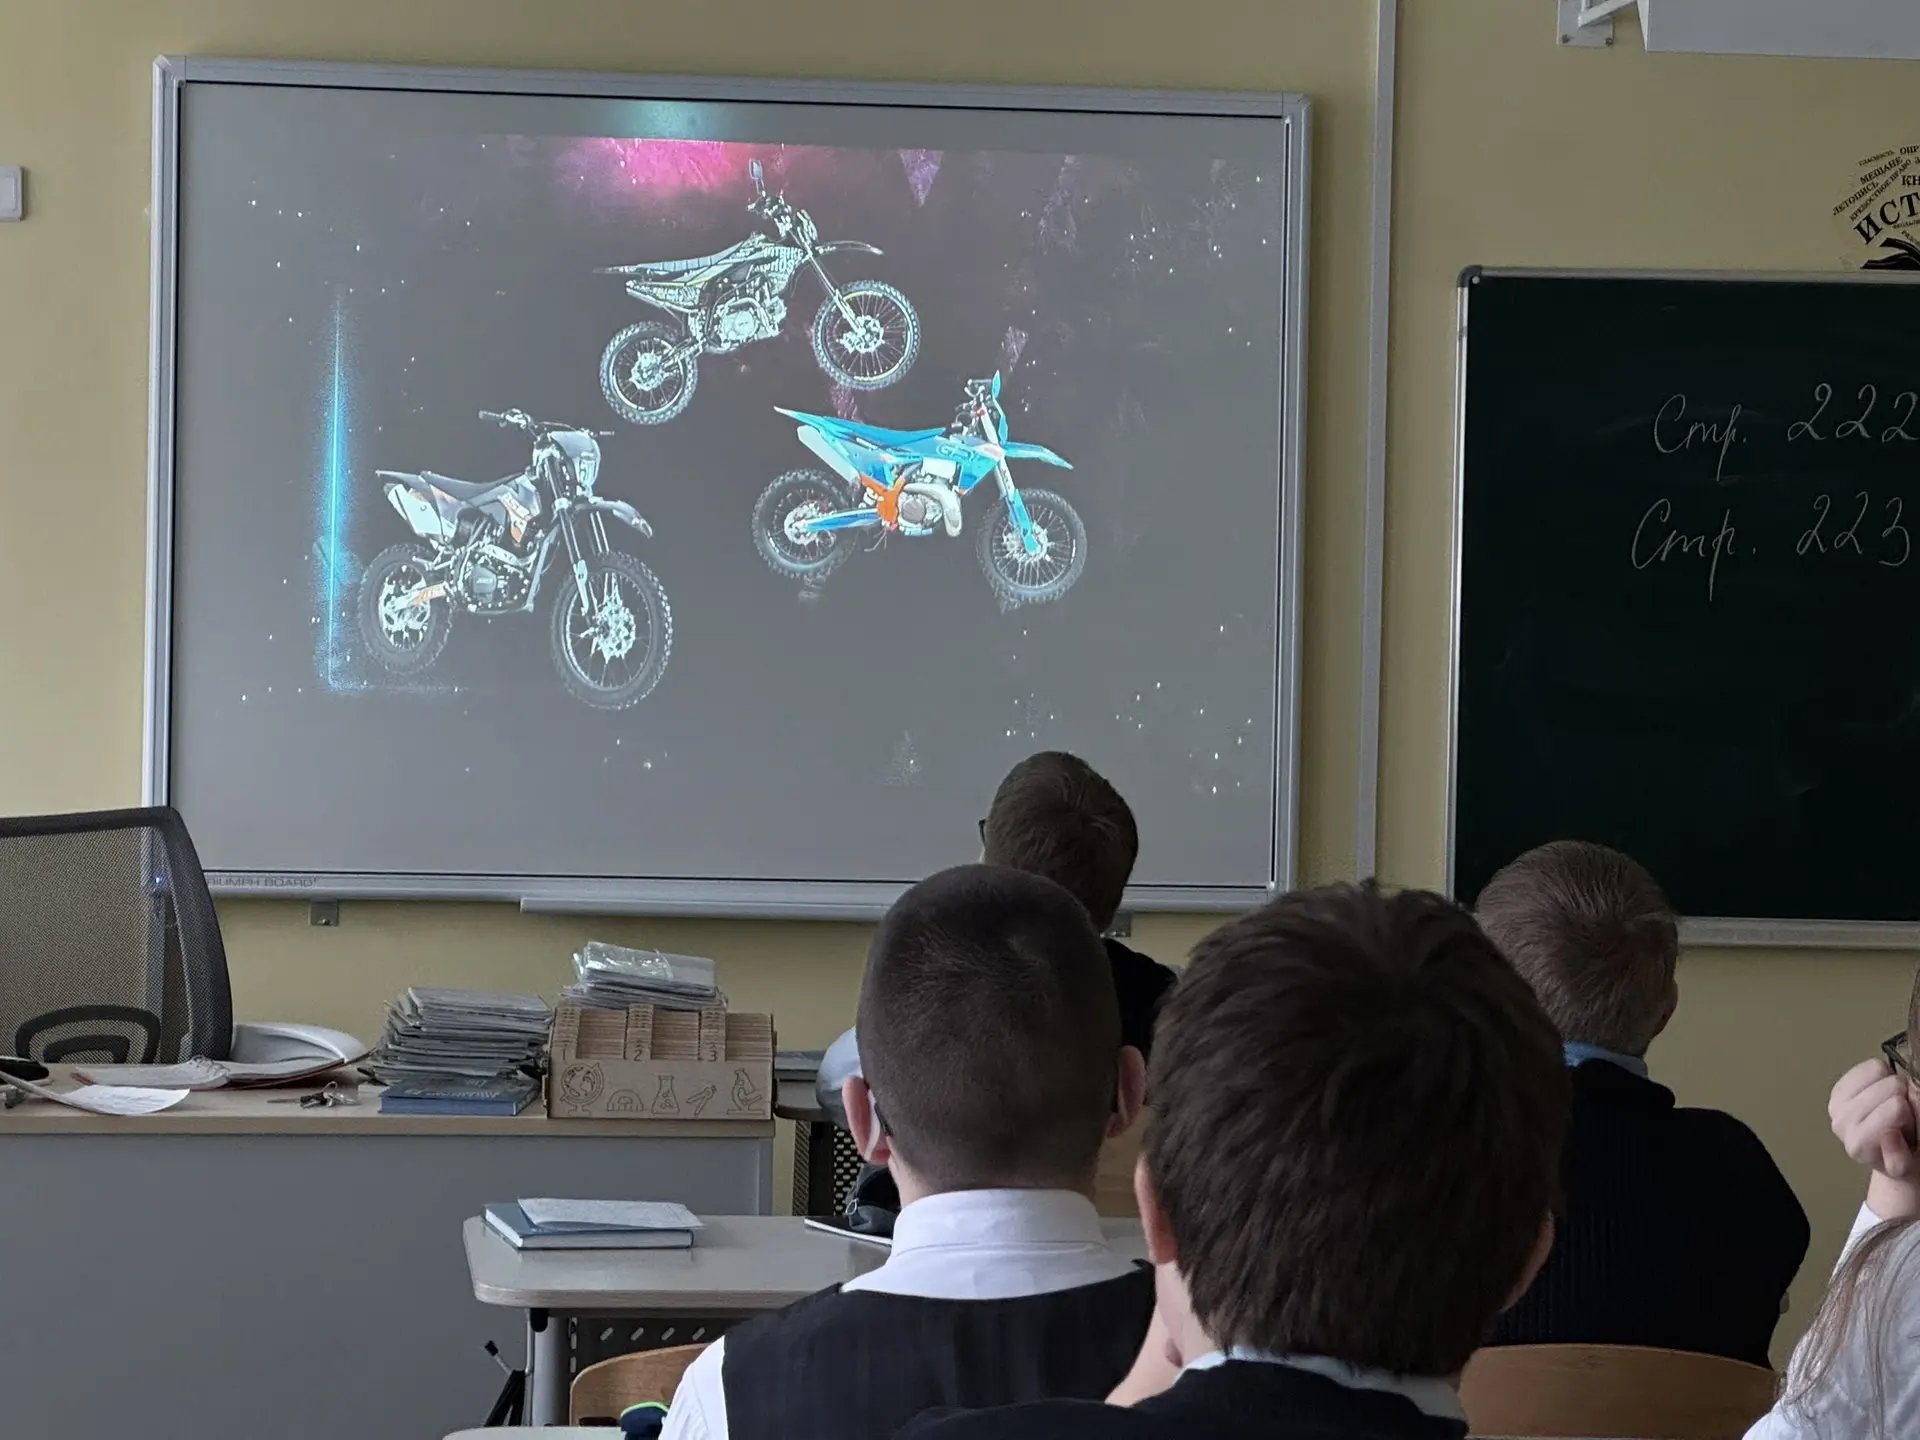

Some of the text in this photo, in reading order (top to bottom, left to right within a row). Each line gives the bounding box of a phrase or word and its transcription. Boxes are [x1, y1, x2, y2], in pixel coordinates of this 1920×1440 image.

[1899, 144, 1920, 156] ОПР
[1860, 155, 1904, 185] МЕЩАНЕ
[1832, 180, 1880, 216] ЛЕТОПИСЬ
[1853, 191, 1920, 245] ИСТ
[1787, 382, 1920, 443] 222
[1796, 491, 1912, 567] 223
[207, 877, 260, 887] RIUMPH
[633, 1048, 642, 1062] 2
[708, 1048, 717, 1062] 3
